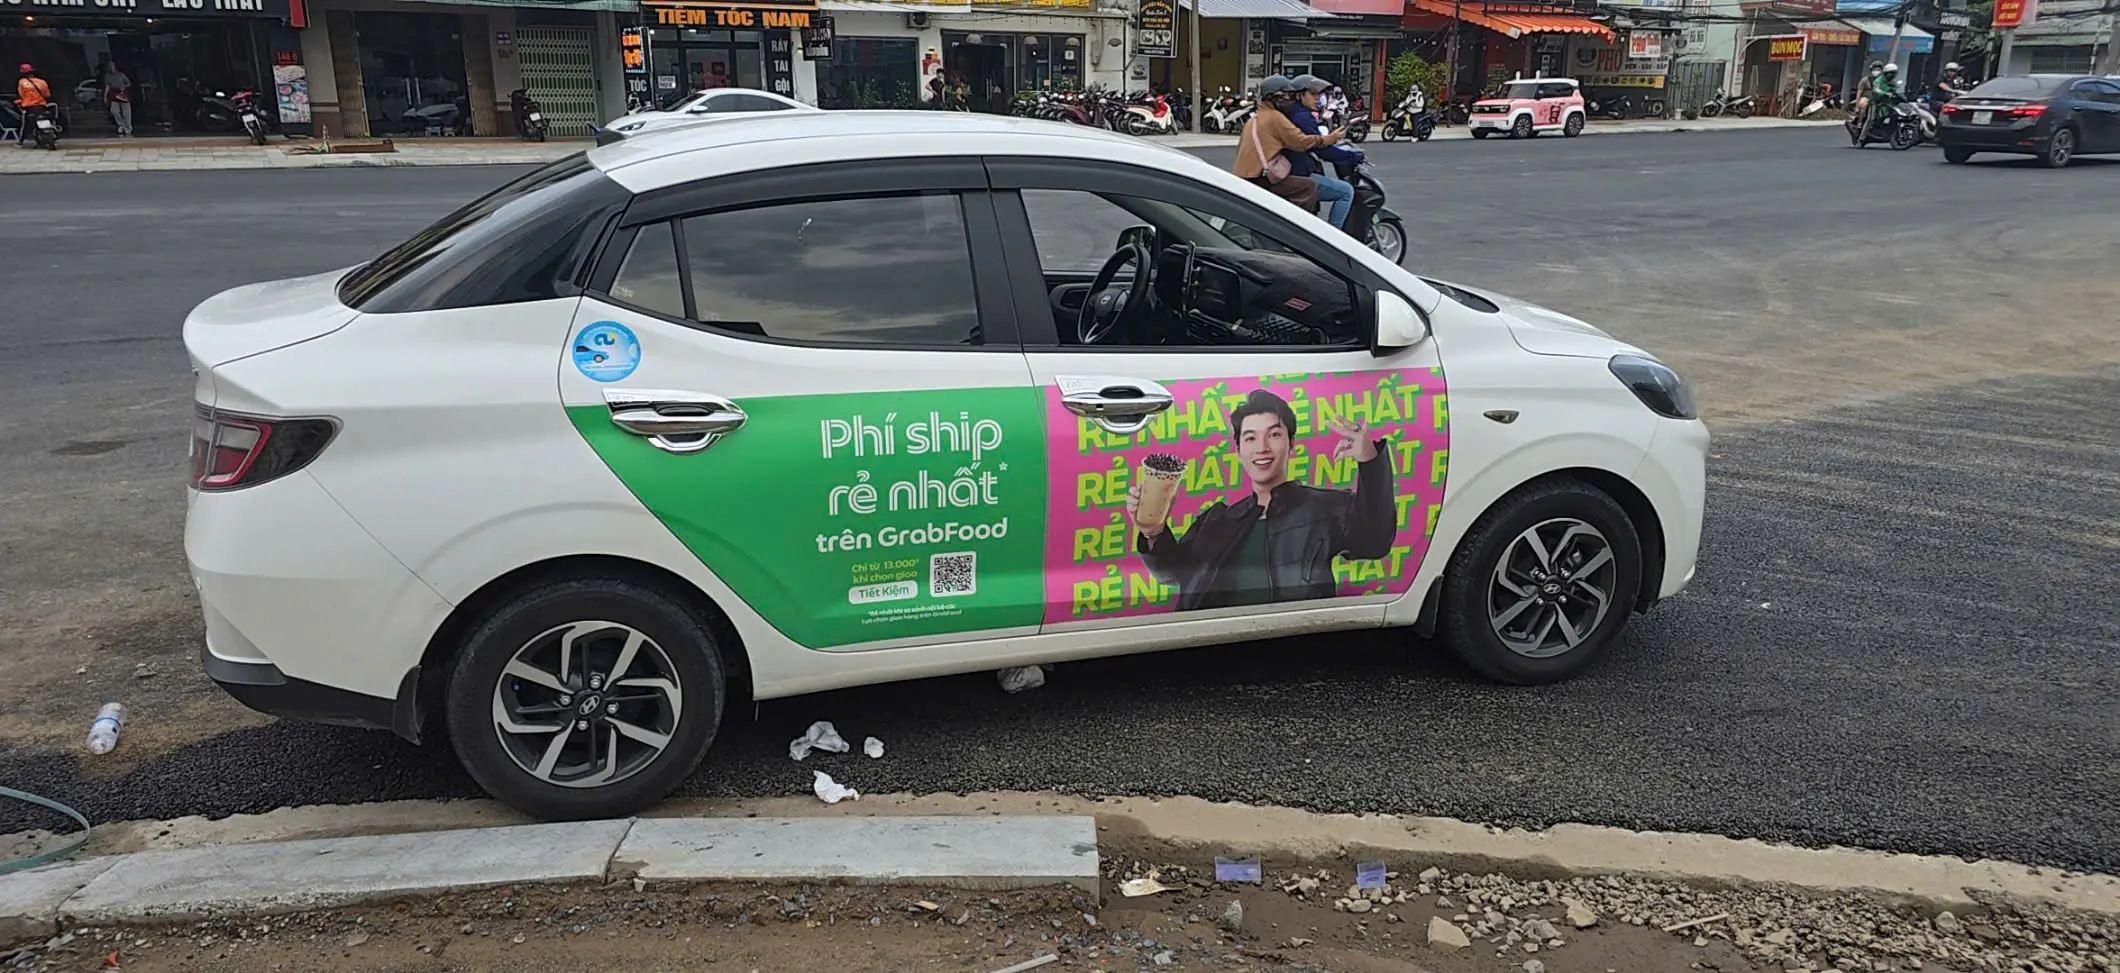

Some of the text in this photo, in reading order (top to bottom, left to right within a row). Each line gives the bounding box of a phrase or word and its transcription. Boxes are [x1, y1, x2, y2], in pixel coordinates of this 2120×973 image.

[655, 5, 810, 28] TIỆM TÓC NAM
[774, 60, 788, 72] TAI
[629, 77, 647, 92] TÓC
[775, 78, 790, 94] GỘI
[1315, 373, 1421, 432] NHẤT
[821, 411, 1003, 460] Phí ship
[828, 470, 878, 516] rẻ
[1077, 456, 1130, 509] RẺ
[816, 517, 1008, 553] trên GrabFood
[1073, 512, 1127, 562] RẺ
[853, 574, 868, 584] khi
[896, 571, 918, 580] giao
[858, 585, 909, 598] Tiết Kiệm
[1072, 564, 1124, 616] RẺ
